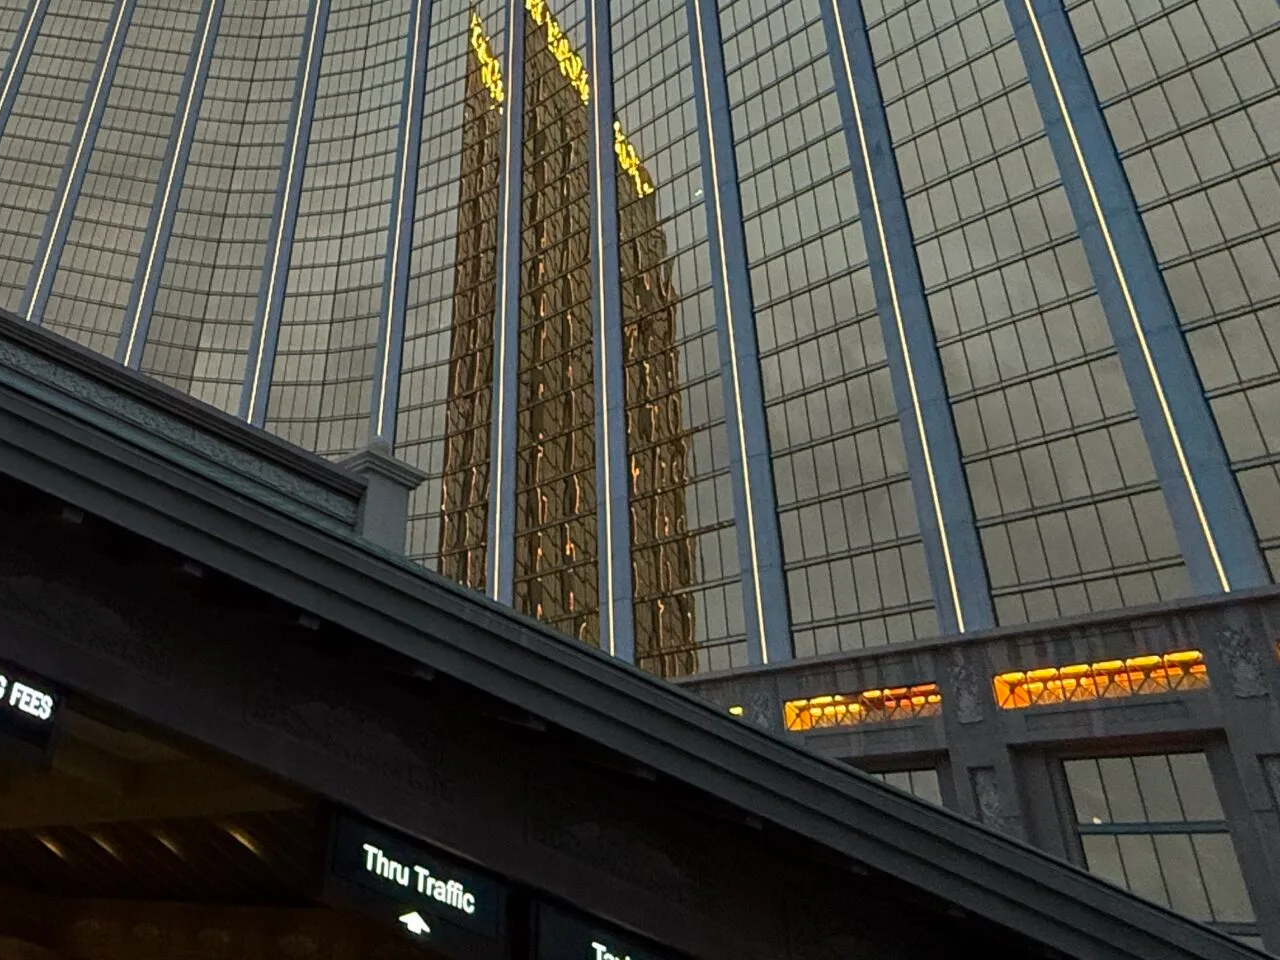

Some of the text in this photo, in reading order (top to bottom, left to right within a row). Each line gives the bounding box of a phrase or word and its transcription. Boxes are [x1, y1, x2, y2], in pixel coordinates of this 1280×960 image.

[8, 681, 54, 721] FEES
[362, 843, 476, 915] Thru Traffic
